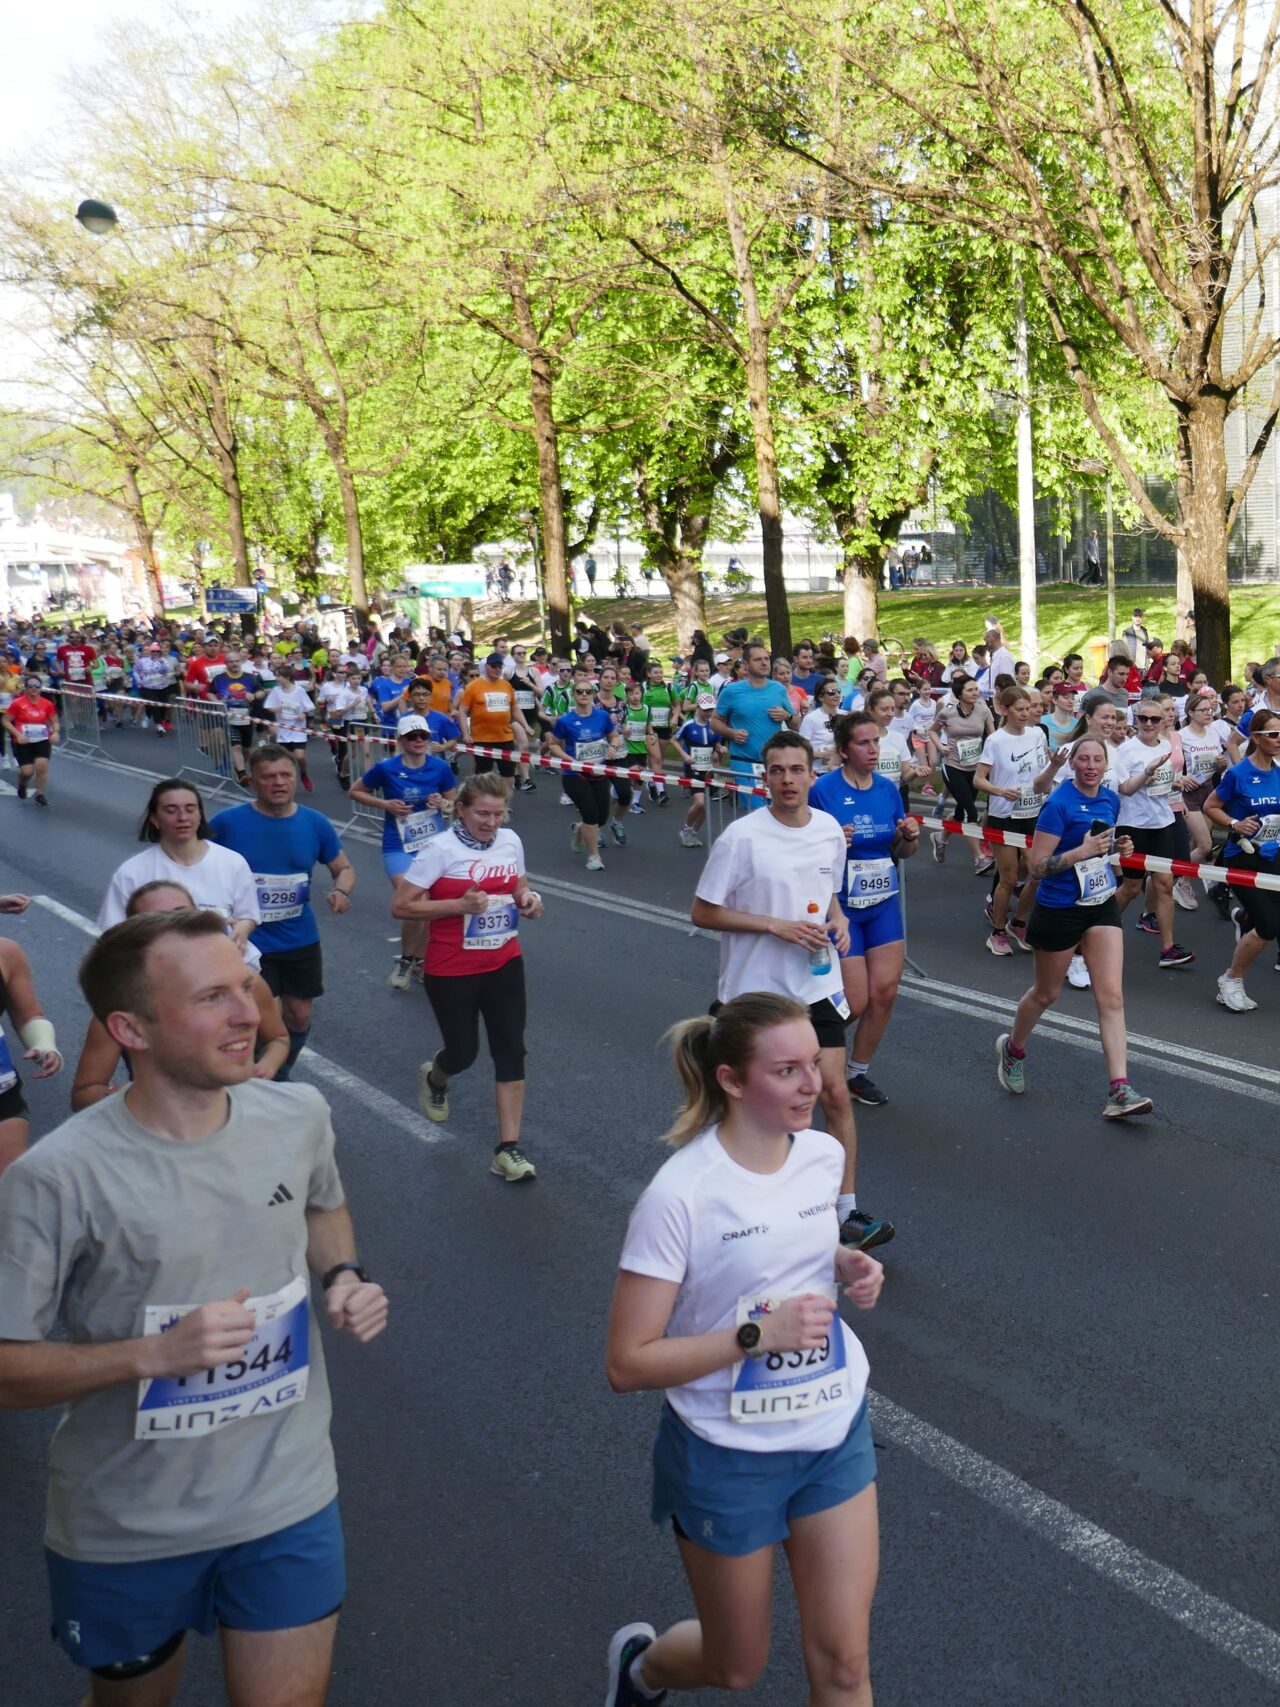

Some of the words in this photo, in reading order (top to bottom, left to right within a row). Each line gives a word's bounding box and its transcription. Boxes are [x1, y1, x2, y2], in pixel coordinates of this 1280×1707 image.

[1251, 797, 1277, 806] LINZ
[410, 823, 436, 837] 9473
[860, 877, 890, 890] 9495
[1089, 875, 1109, 890] 9461
[262, 892, 296, 904] 9298
[478, 915, 511, 930] 9373
[722, 1225, 760, 1241] CRAFT
[741, 1393, 810, 1415] LINZ
[815, 1383, 842, 1406] AG
[150, 1404, 241, 1431] LINZ
[251, 1383, 298, 1413] AG
